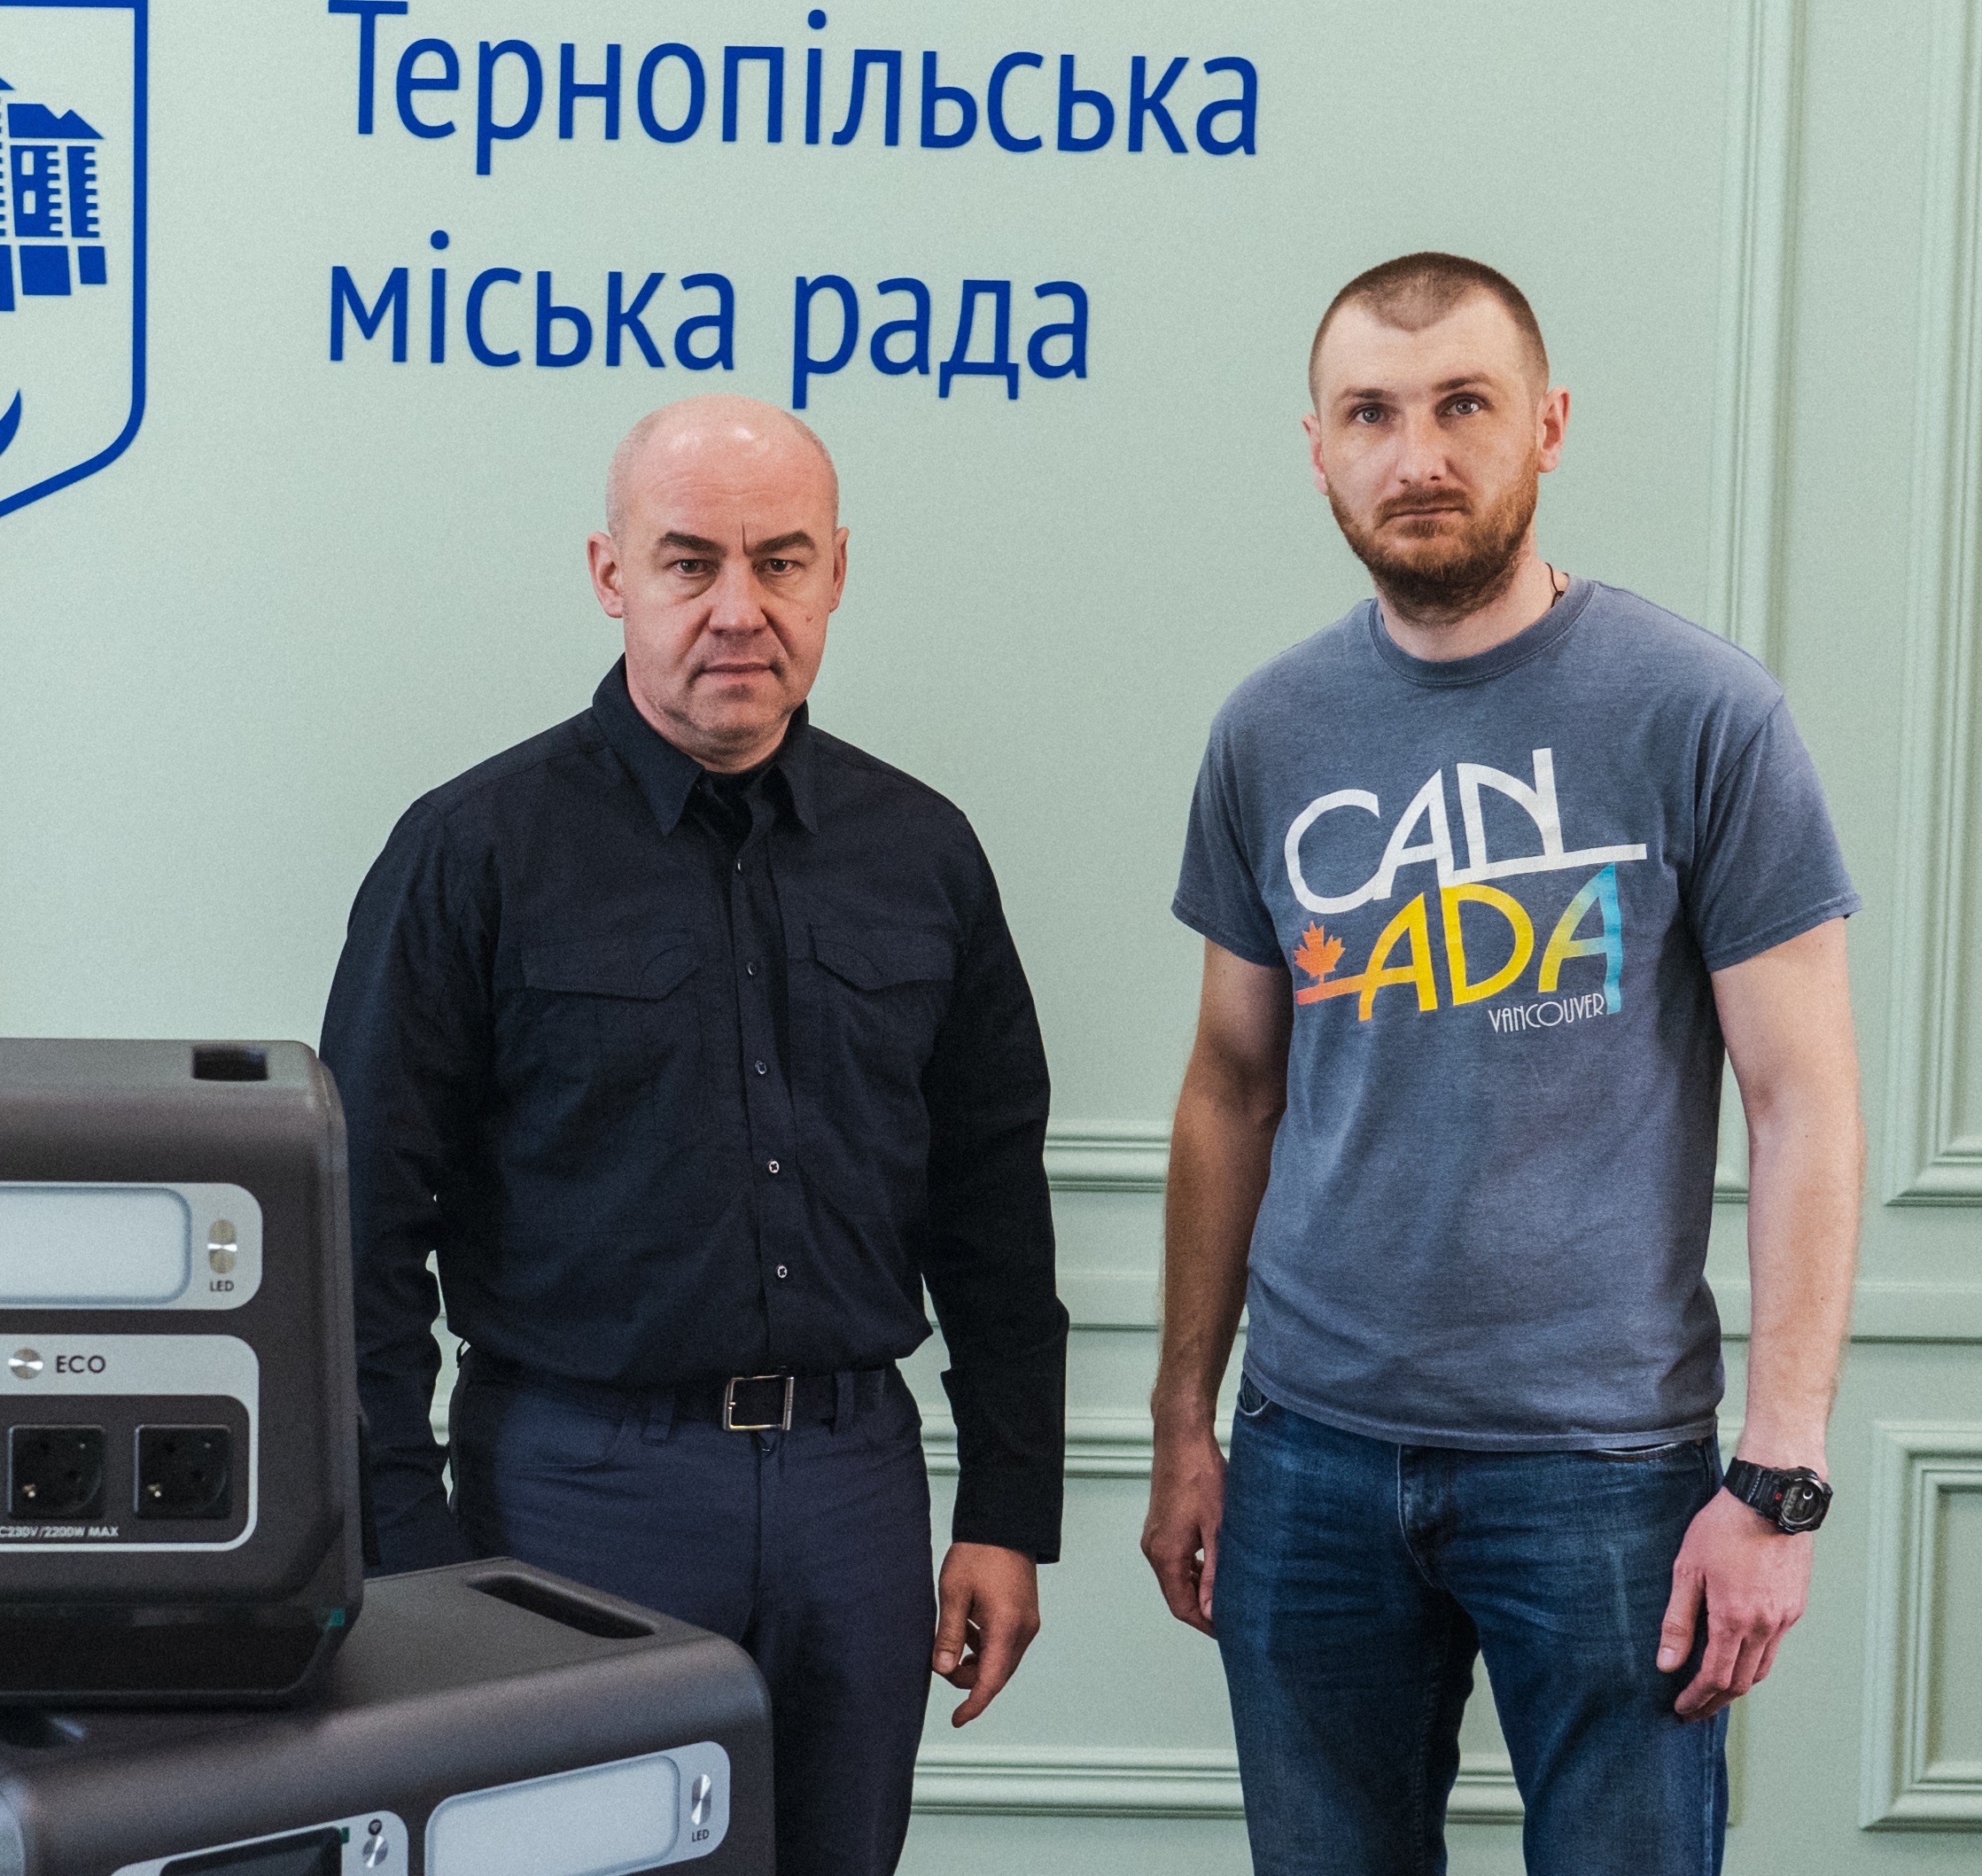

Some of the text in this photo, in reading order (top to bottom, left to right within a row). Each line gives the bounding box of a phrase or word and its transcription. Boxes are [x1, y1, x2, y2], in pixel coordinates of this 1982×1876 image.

[328, 0, 1257, 175] Тернопільська
[330, 230, 1088, 409] міська рада
[1285, 748, 1647, 915] CAN
[1296, 862, 1622, 1022] ADA
[1488, 992, 1605, 1033] VANCOUVER
[209, 1280, 235, 1292] LED
[56, 1355, 105, 1374] ECO
[88, 1526, 119, 1537] MAX
[691, 1828, 710, 1842] LED
